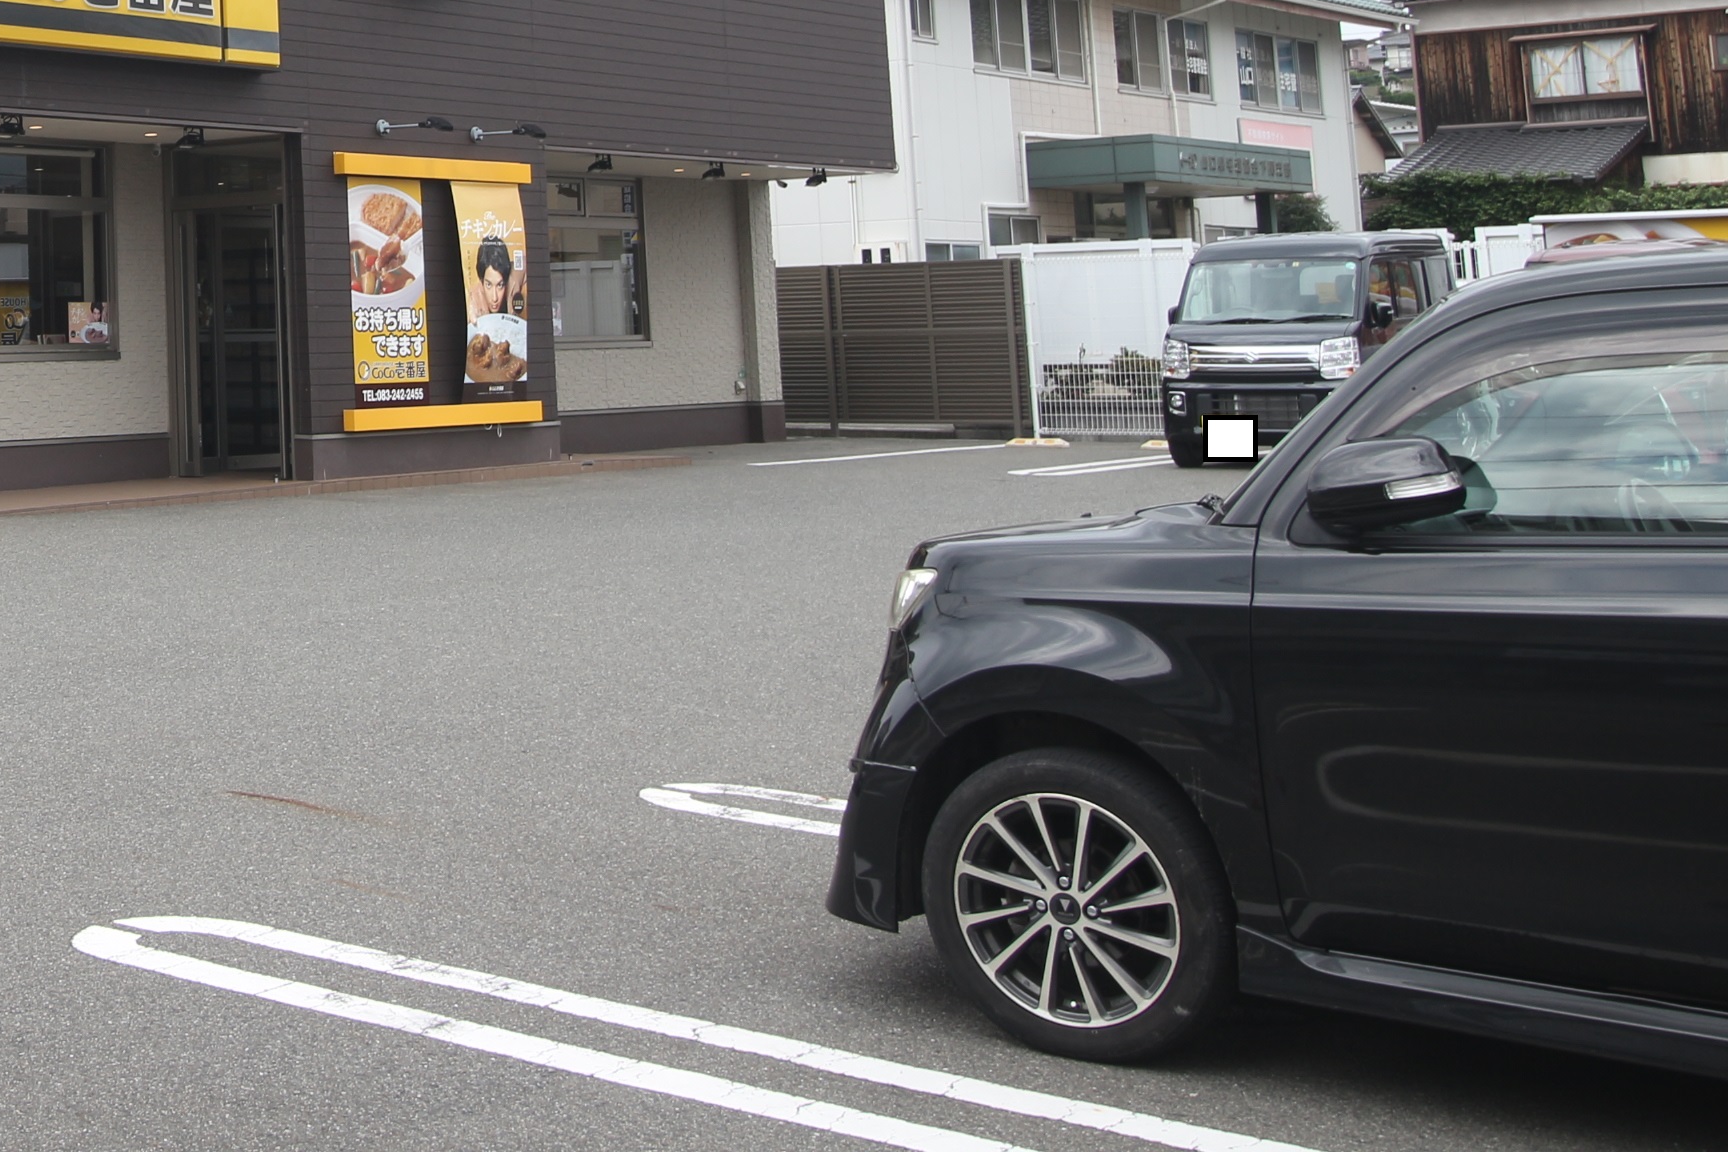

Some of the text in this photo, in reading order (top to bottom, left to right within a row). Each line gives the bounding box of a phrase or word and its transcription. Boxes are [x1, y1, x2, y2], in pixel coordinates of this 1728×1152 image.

[461, 218, 522, 240] チキンカレー
[354, 307, 424, 332] お持ち帰り
[371, 333, 425, 358] できます
[372, 361, 426, 379] CoCo壱番屋
